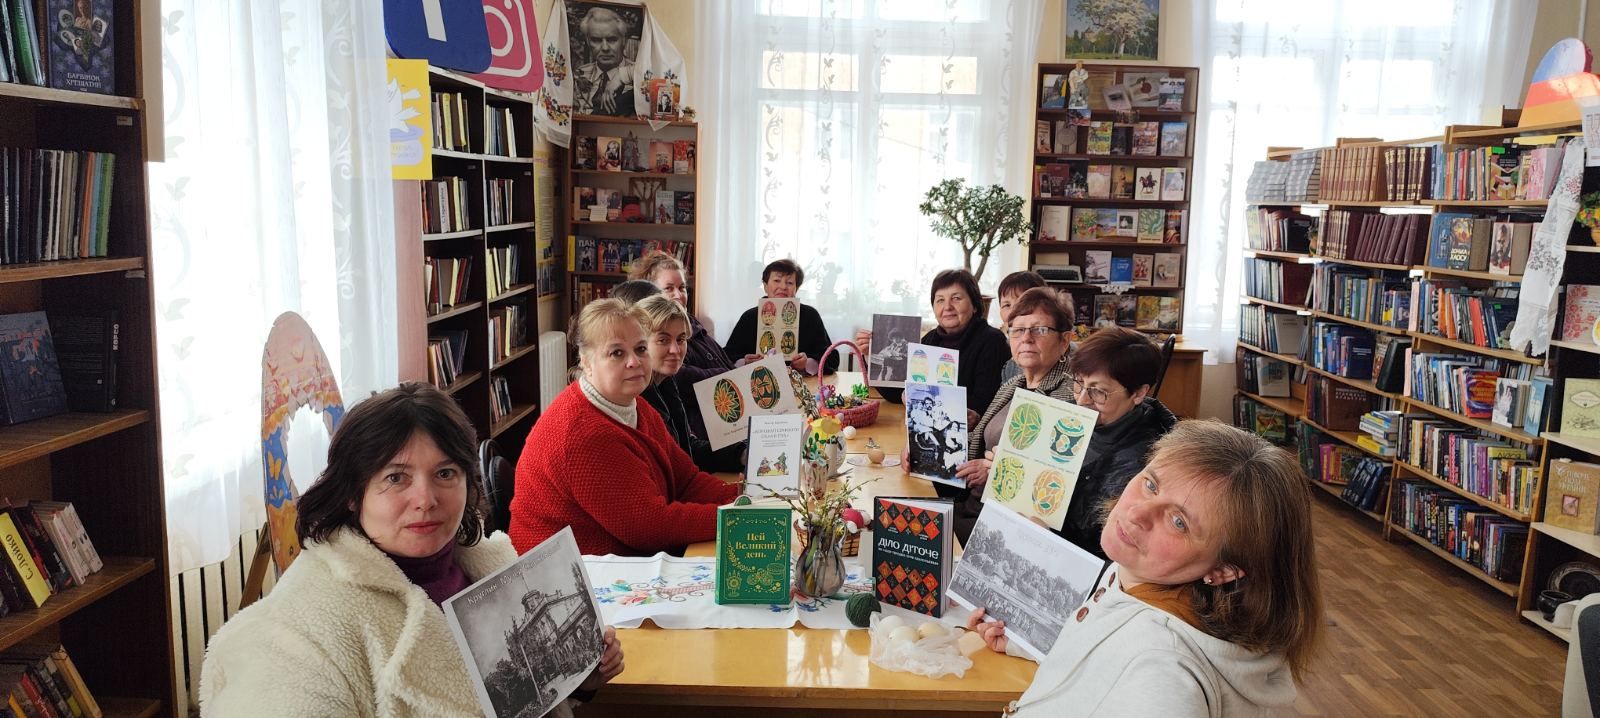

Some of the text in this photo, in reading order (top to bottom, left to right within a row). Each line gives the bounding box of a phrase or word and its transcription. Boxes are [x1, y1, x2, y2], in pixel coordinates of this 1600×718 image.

[67, 72, 100, 81] БАРВІНОК
[66, 79, 102, 89] ХРЕЩАТИЙ
[746, 532, 766, 541] Цей
[735, 540, 777, 550] Великий
[877, 537, 900, 550] ДІЛО
[466, 583, 498, 606] Круглик
